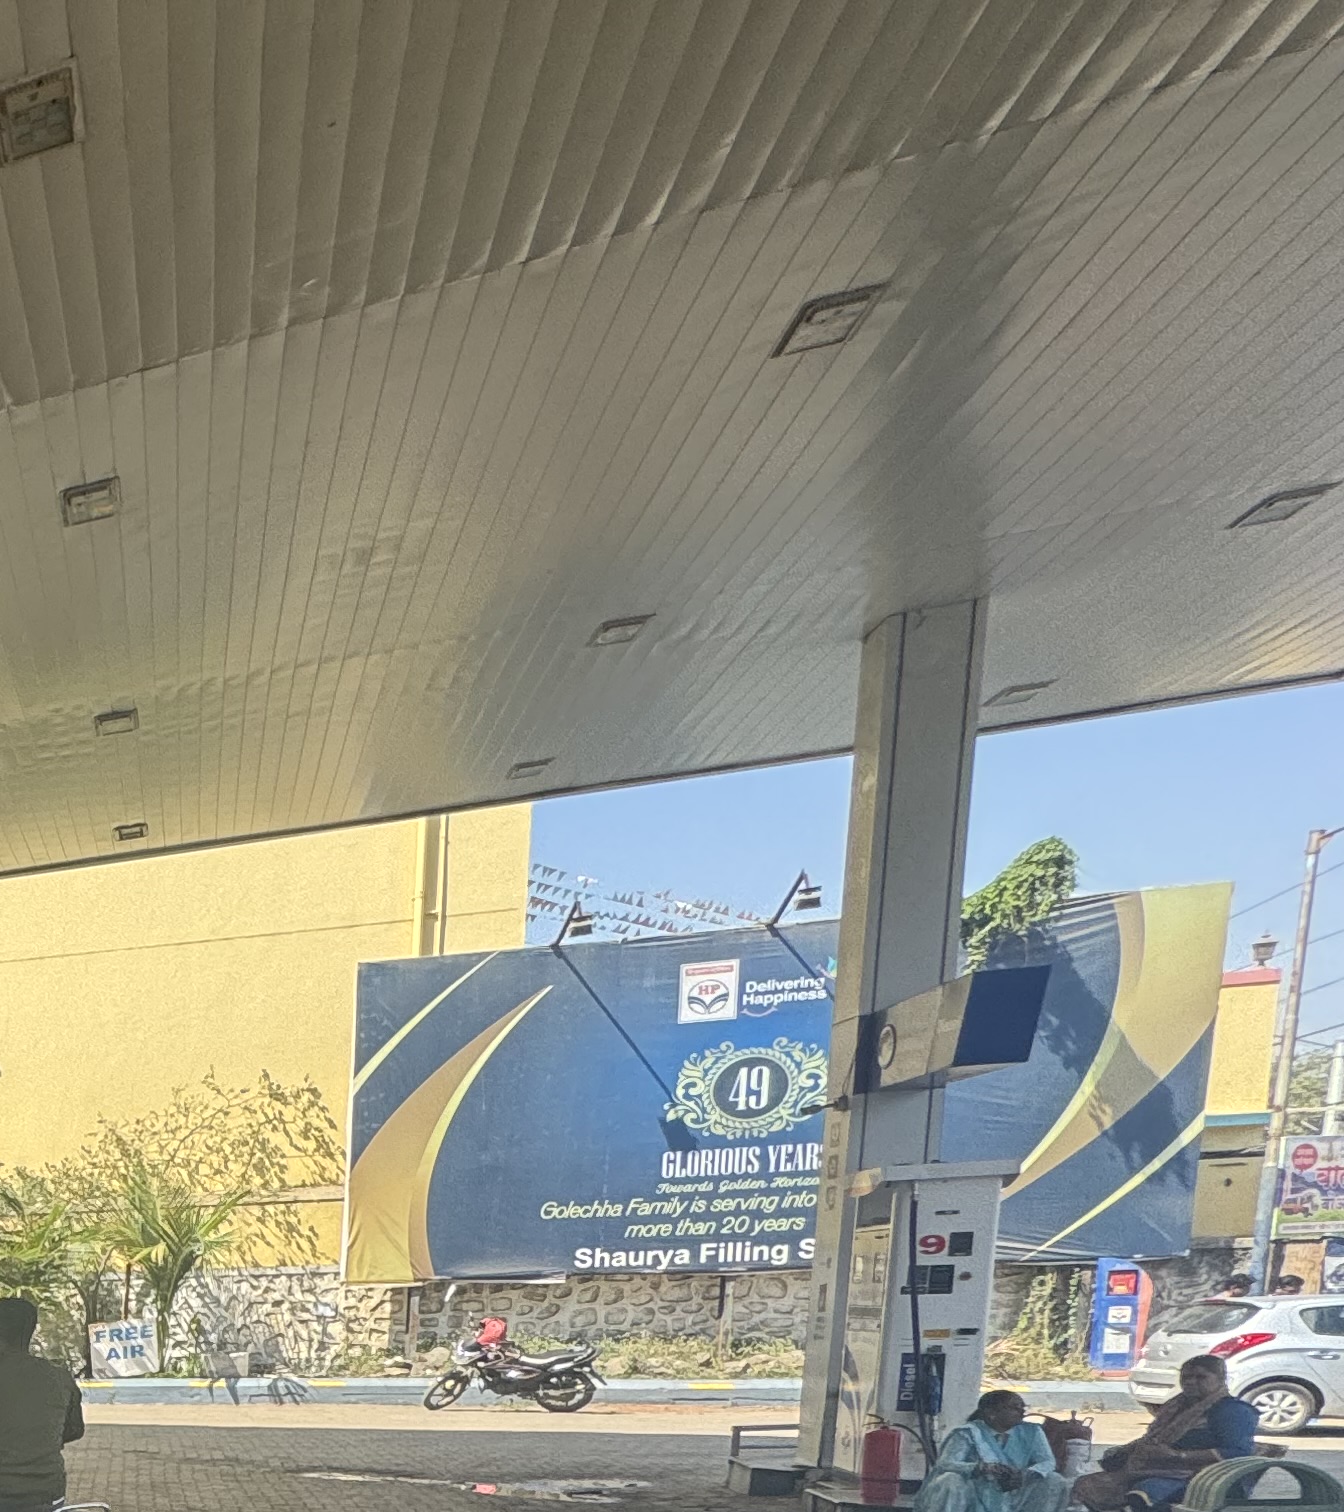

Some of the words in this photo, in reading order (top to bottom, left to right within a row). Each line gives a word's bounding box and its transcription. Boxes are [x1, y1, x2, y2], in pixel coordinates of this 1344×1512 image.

[698, 984, 721, 996] HP
[745, 976, 826, 993] Delivering
[742, 989, 828, 1006] Happiness
[728, 1065, 771, 1111] 49
[661, 1146, 761, 1179] GLORIOUS
[768, 1142, 823, 1173] YEAR
[656, 1180, 714, 1194] Towards
[717, 1179, 769, 1193] Golden
[540, 1200, 624, 1220] Golechha
[625, 1196, 689, 1218] Family
[689, 1196, 708, 1213] is
[710, 1193, 780, 1213] serving
[781, 1190, 818, 1209] into
[624, 1222, 673, 1239] more
[675, 1218, 717, 1237] than
[720, 1215, 751, 1234] 20
[750, 1217, 807, 1236] years
[573, 1247, 691, 1270] Shaurya
[699, 1240, 790, 1265] Filling
[918, 1234, 946, 1256] 9
[93, 1324, 154, 1343] FREE
[105, 1344, 147, 1361] AIR
